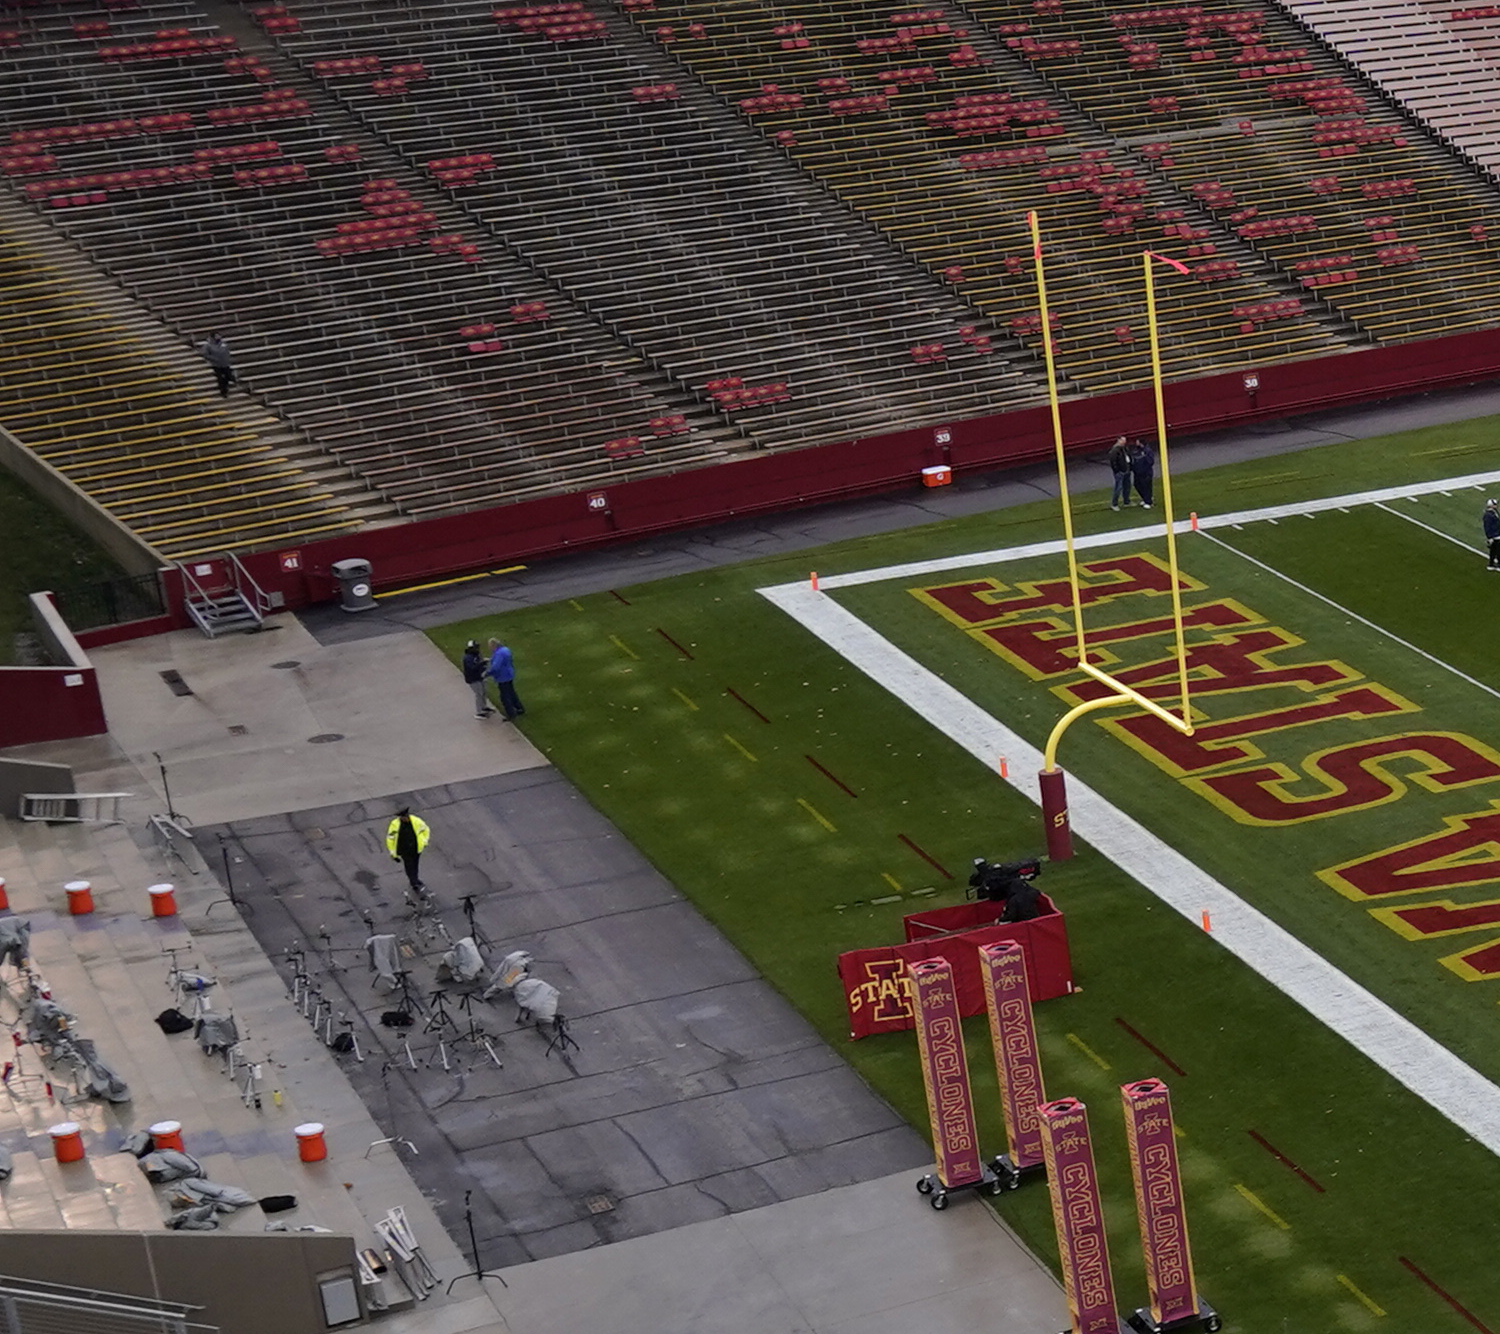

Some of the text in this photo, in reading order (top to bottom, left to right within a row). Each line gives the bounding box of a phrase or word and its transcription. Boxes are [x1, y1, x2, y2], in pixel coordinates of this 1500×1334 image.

[850, 977, 913, 1014] STAT
[929, 1016, 973, 1155] CYCLONES
[1001, 998, 1042, 1134] CYCLONES
[1062, 1160, 1109, 1311] CYCLONES
[1143, 1142, 1186, 1291] CYCLONES
